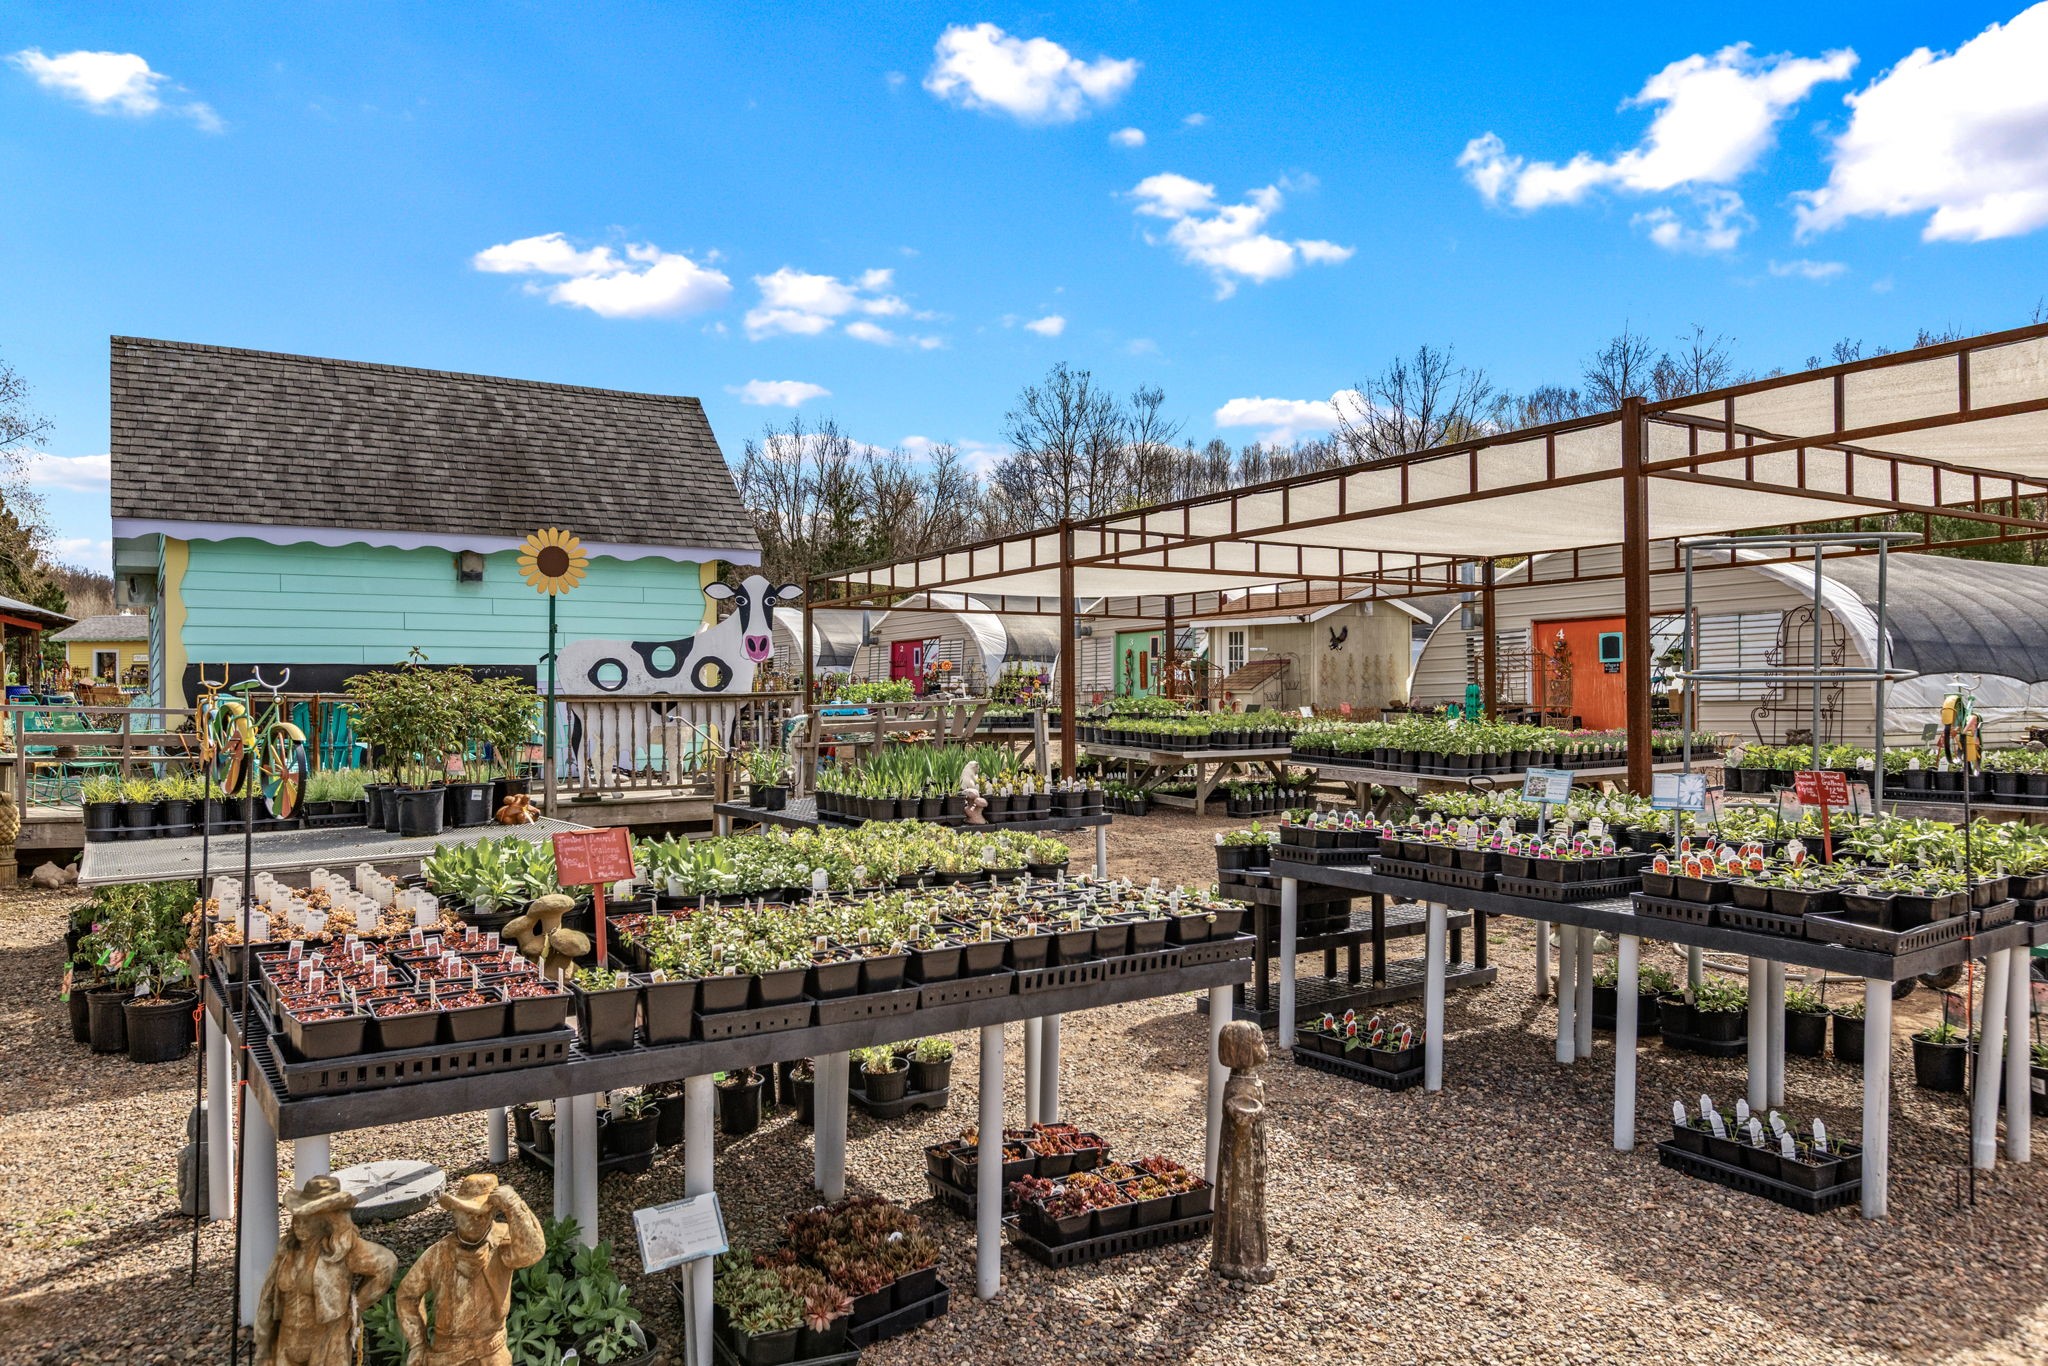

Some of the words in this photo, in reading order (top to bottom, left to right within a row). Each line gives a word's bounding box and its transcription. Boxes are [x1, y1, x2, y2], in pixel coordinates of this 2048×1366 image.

[1556, 628, 1565, 640] 4
[589, 832, 616, 843] Round
[590, 845, 620, 854] Gallons
